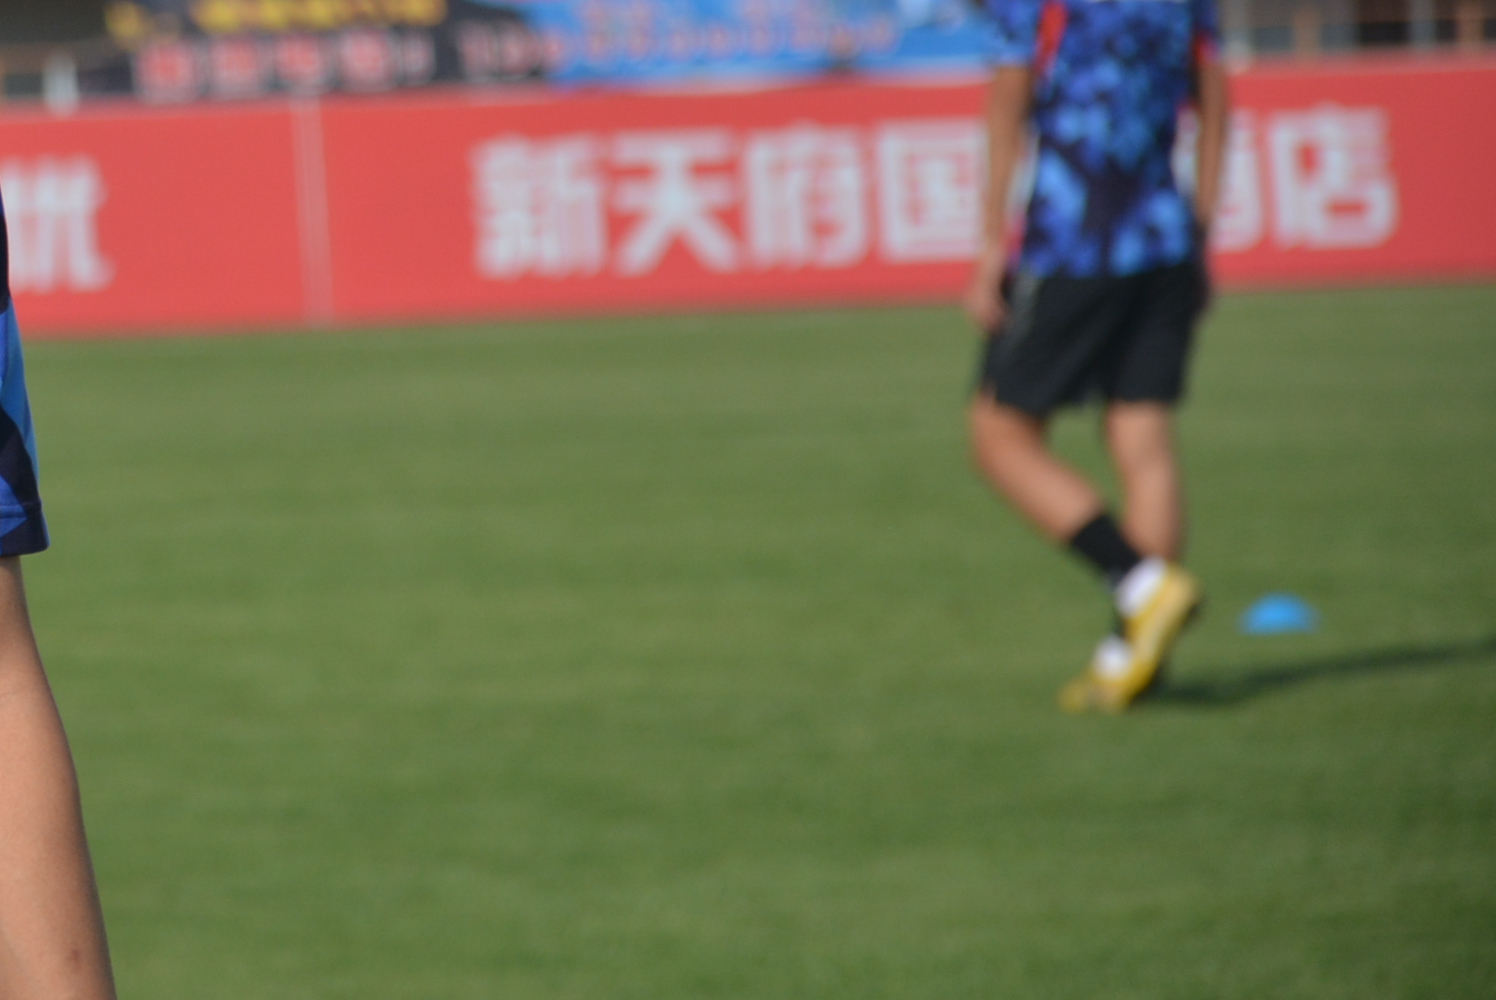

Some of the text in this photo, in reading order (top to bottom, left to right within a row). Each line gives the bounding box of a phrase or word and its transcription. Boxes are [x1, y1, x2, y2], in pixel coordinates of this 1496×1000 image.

[472, 104, 1400, 278] 新天府国店
